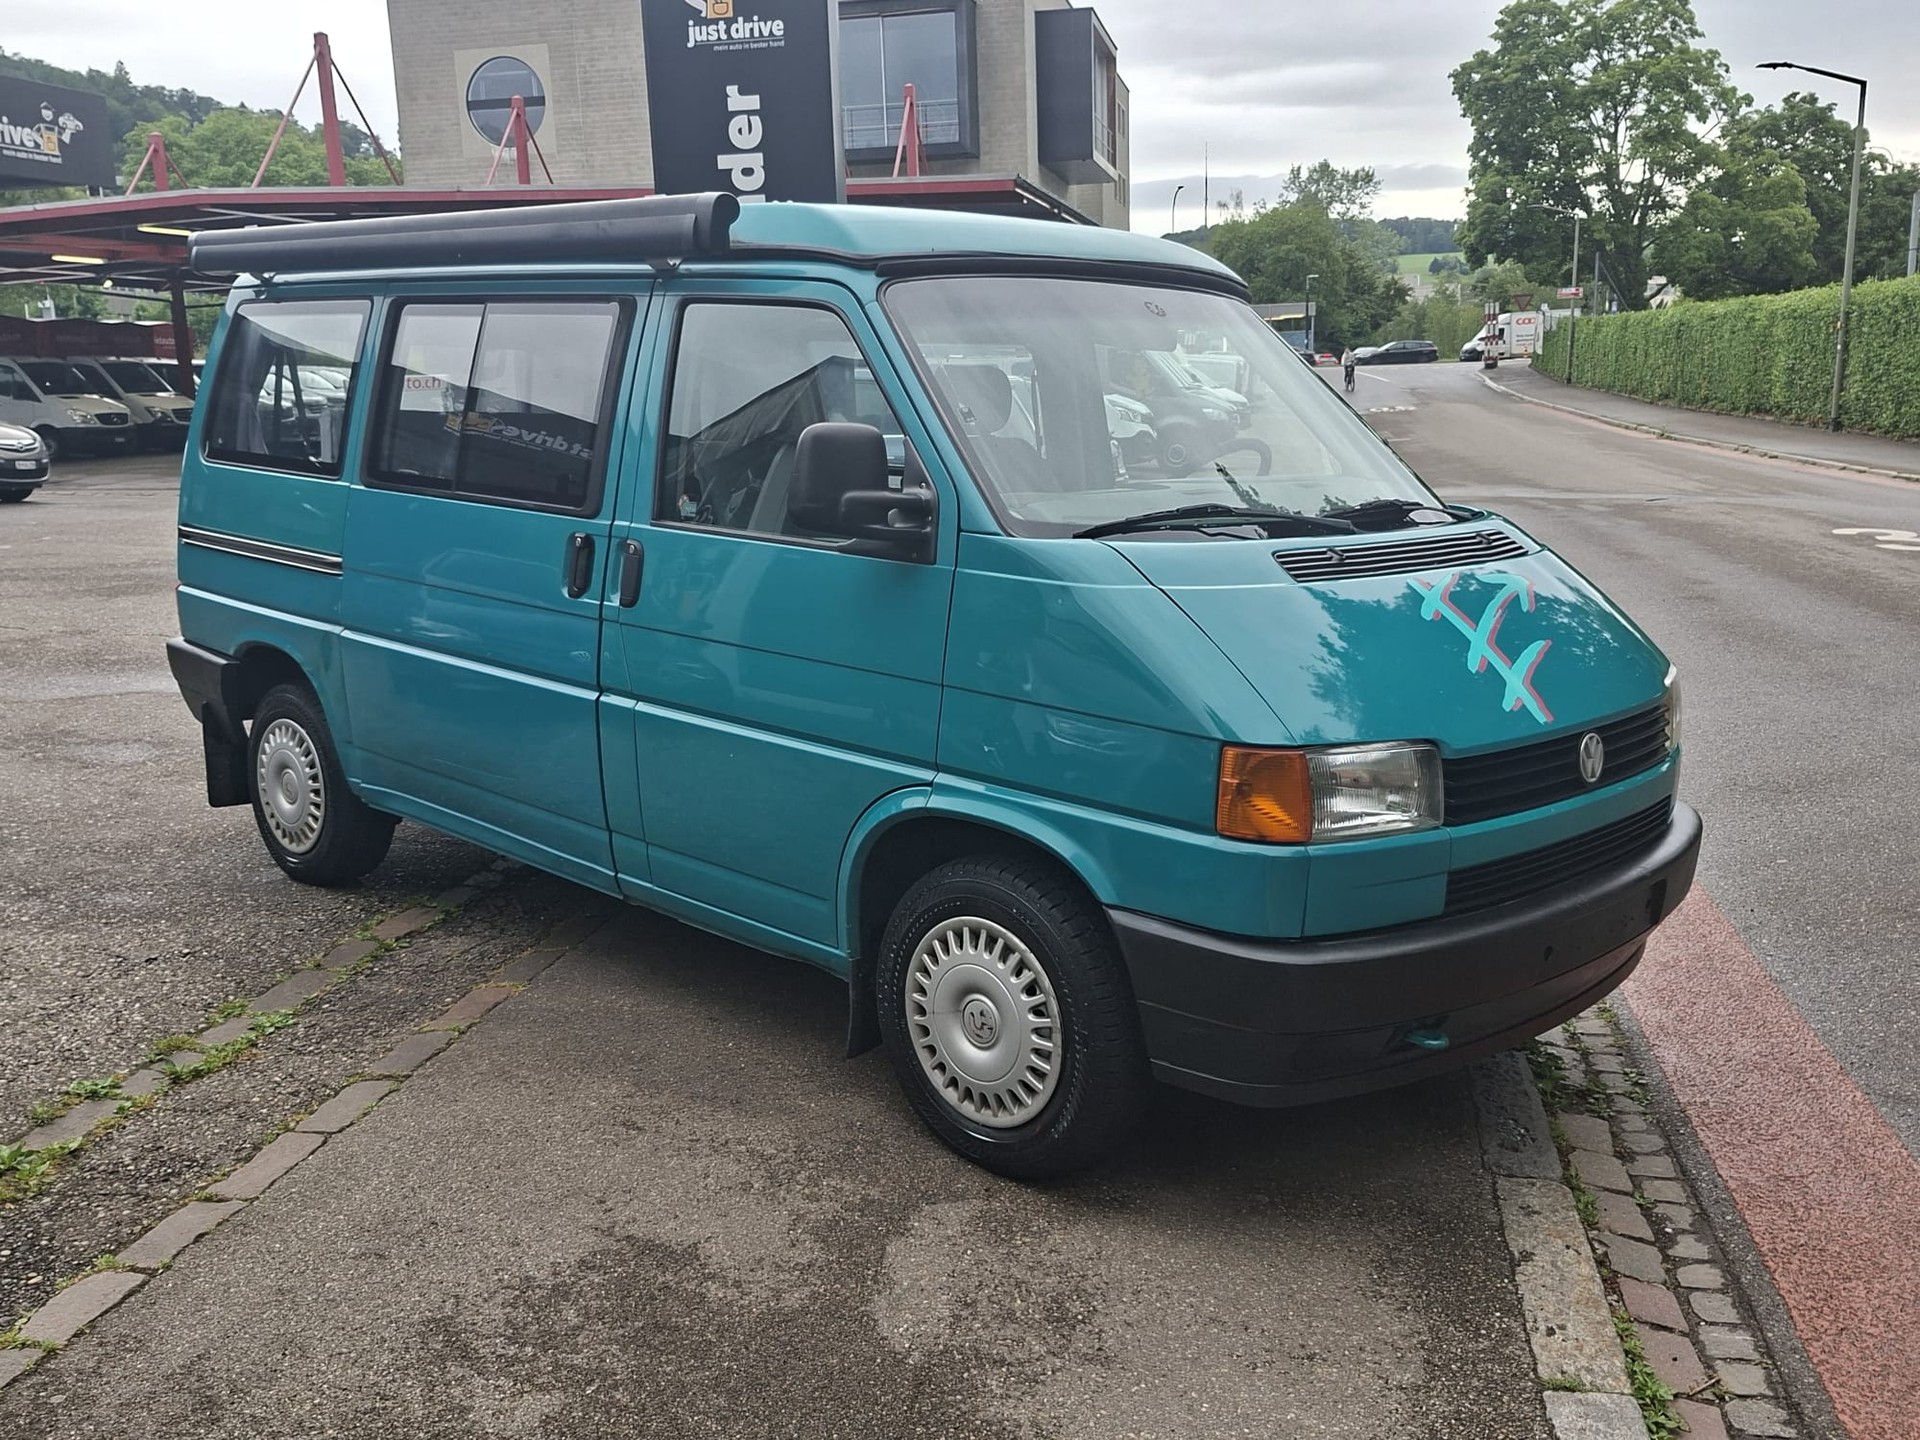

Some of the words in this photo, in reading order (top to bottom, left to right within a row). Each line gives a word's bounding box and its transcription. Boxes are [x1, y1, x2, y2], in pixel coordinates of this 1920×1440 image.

[687, 20, 728, 48] just
[730, 15, 784, 39] drive
[750, 41, 768, 49] bester
[0, 116, 35, 148] rive
[717, 85, 766, 203] der
